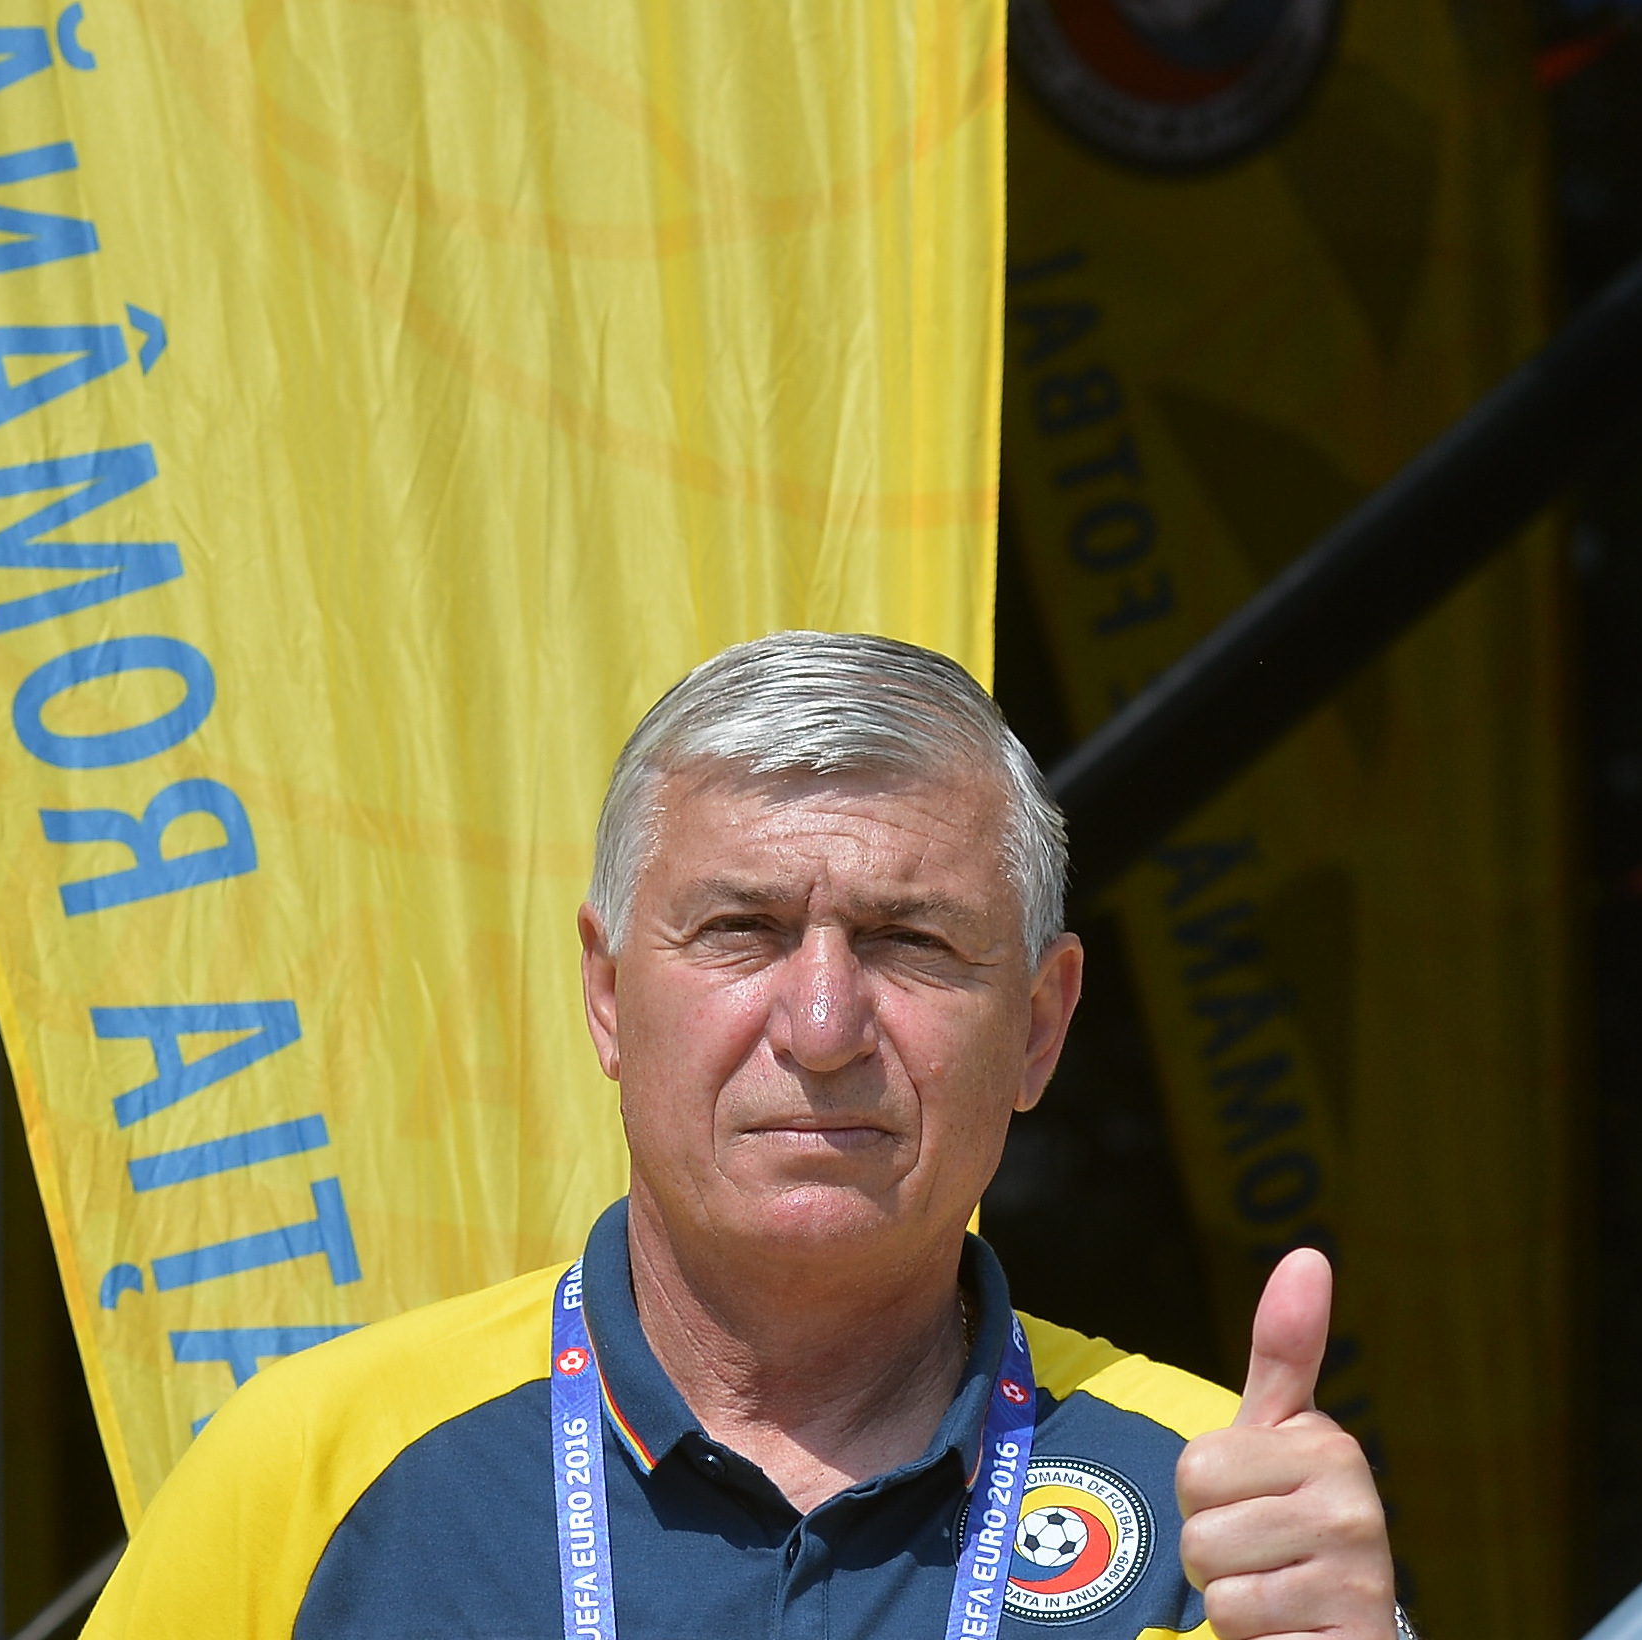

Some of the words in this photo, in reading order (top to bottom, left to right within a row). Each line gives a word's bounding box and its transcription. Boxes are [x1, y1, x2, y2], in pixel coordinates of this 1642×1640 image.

[563, 1417, 590, 1488] 2016
[988, 1441, 1019, 1505] 2016
[568, 1491, 597, 1567] EURO
[1023, 1471, 1083, 1488] OMANA
[1087, 1480, 1108, 1496] DE
[1105, 1490, 1135, 1542] FOTBAL
[973, 1511, 1007, 1581] EURO
[1066, 1583, 1108, 1607] ANUL
